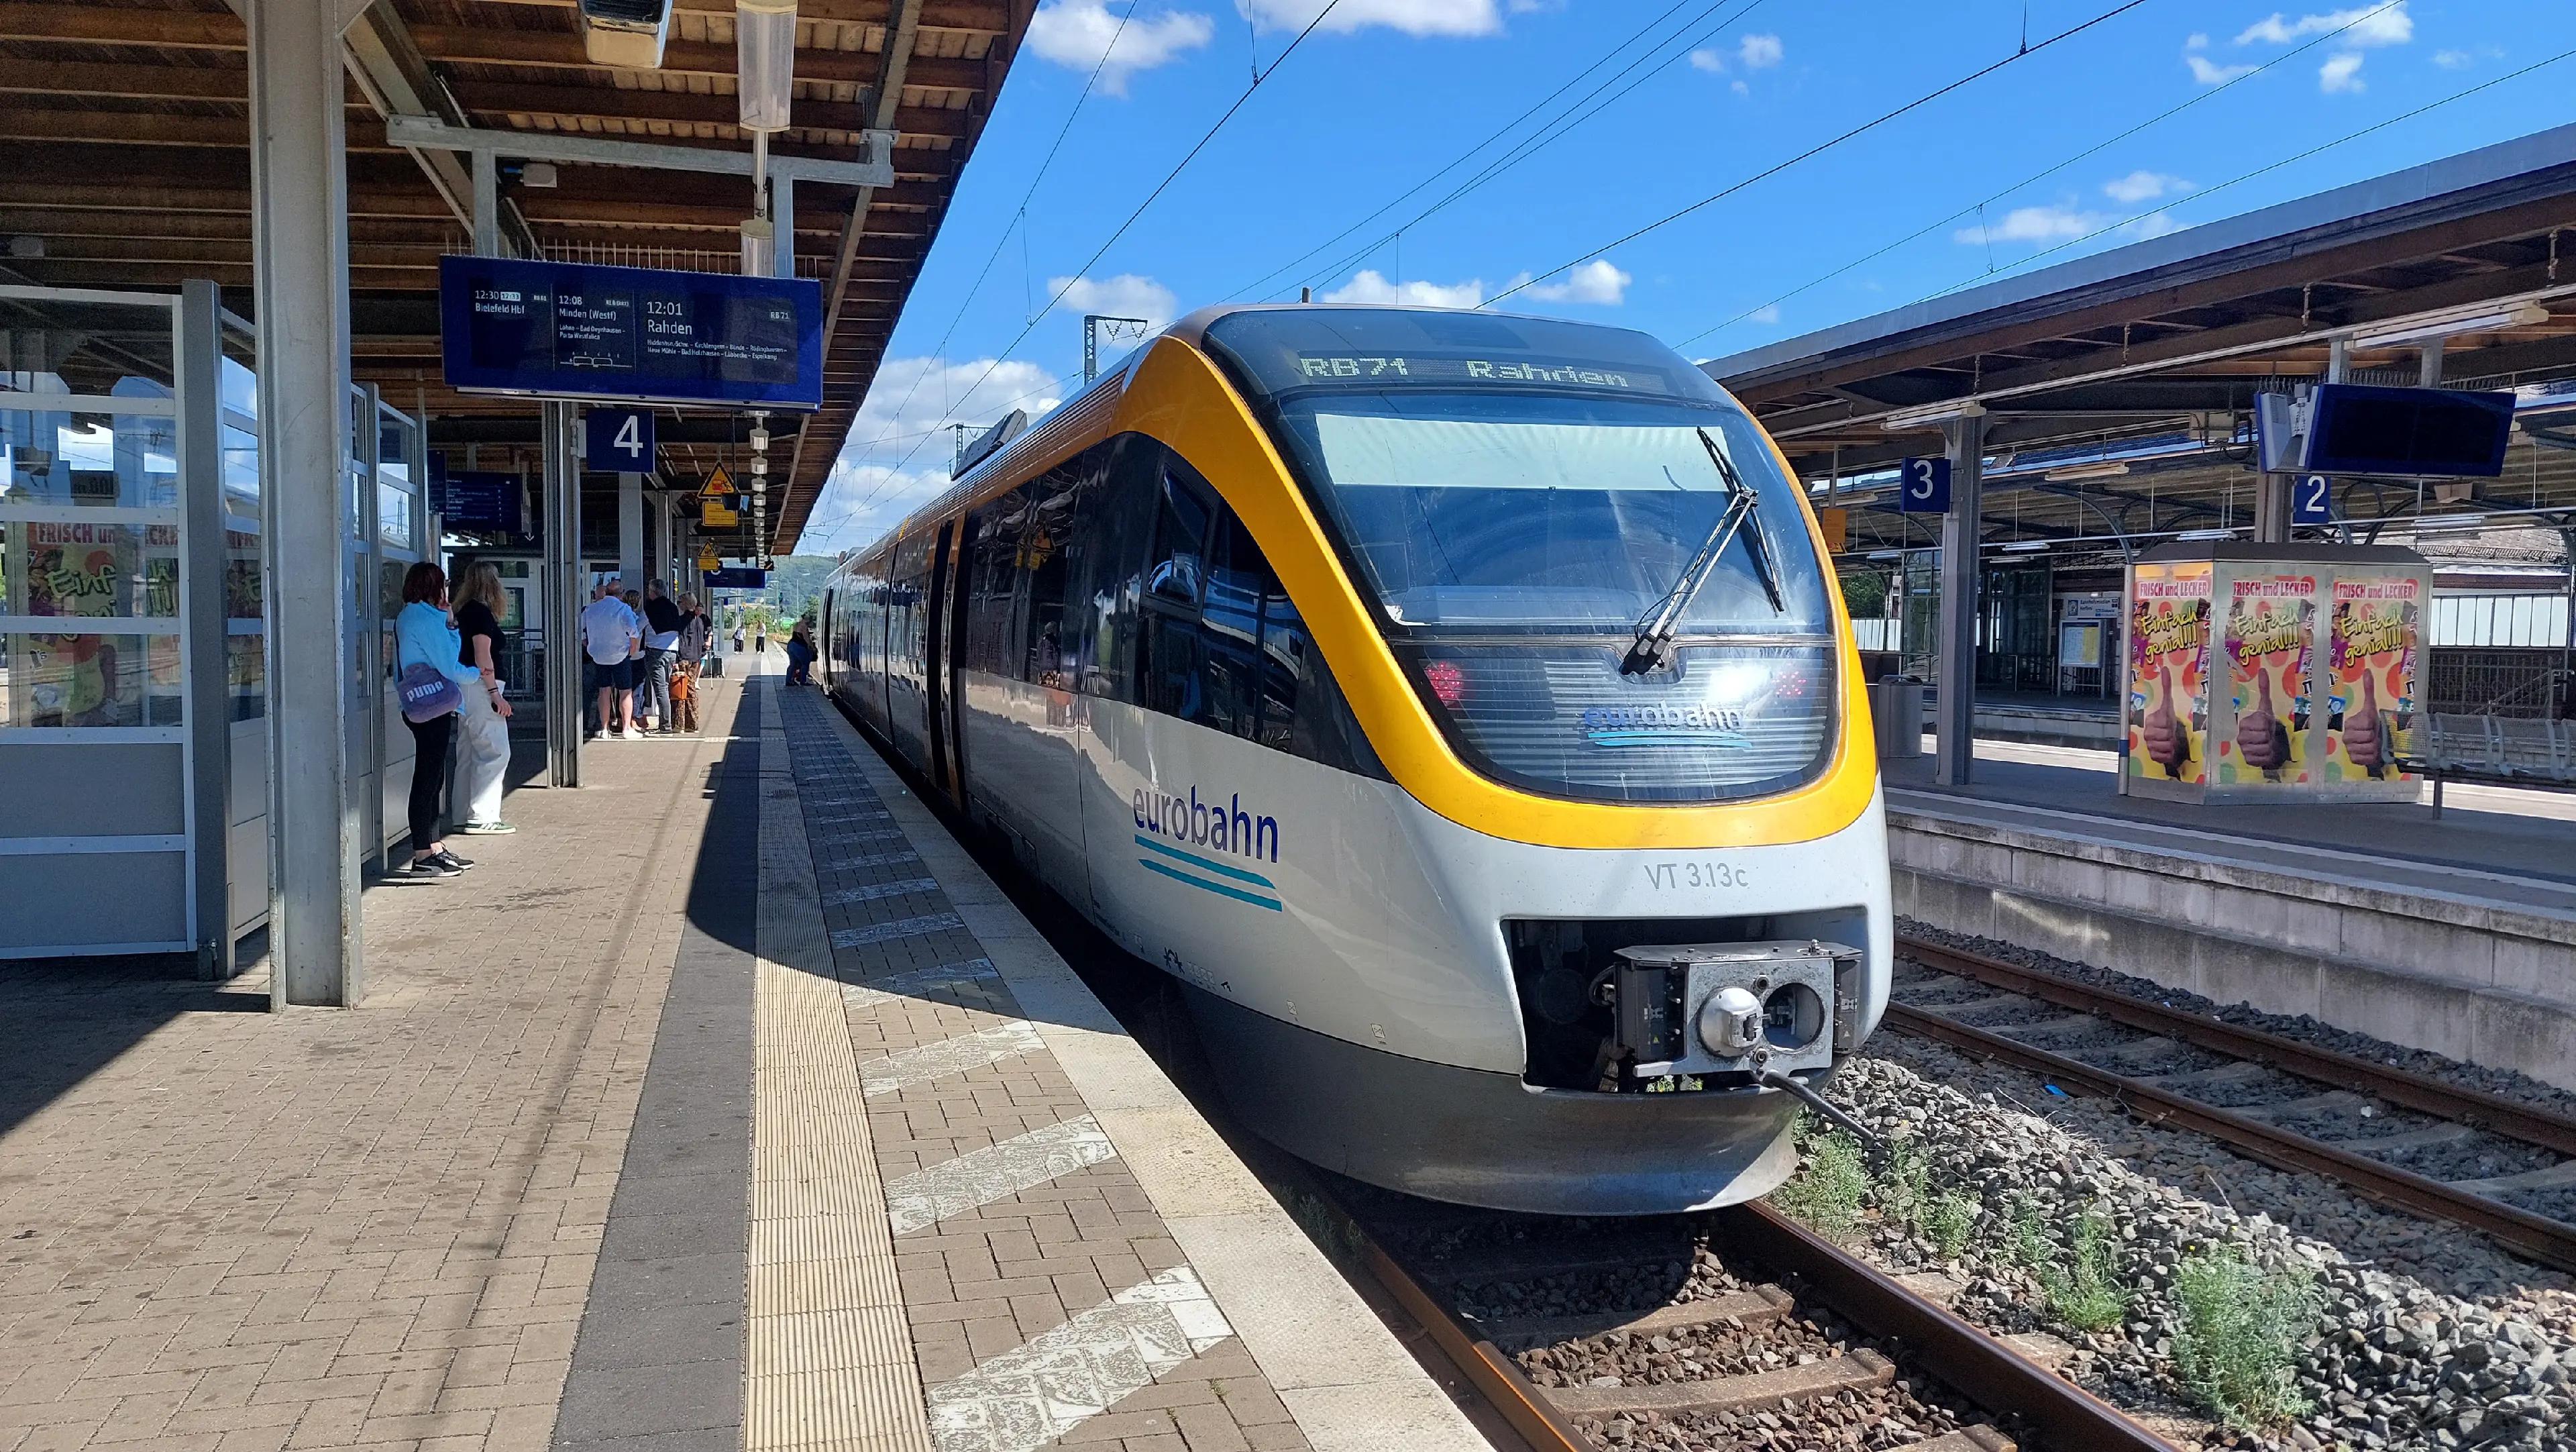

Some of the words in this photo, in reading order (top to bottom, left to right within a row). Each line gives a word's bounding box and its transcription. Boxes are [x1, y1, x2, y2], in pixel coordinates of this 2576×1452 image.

[475, 290, 499, 300] 12:30
[475, 302, 510, 313] Bielefeld
[511, 305, 525, 315] Hbf
[559, 295, 583, 305] 12:08
[647, 301, 683, 316] 12:01
[559, 308, 587, 319] Minden
[589, 309, 616, 321] (Westf)
[647, 319, 693, 335] Rahden
[1300, 358, 1408, 377] RB71
[1466, 360, 1628, 387] Rahden
[614, 415, 643, 458] 4
[1911, 460, 1933, 499] 3
[2305, 475, 2326, 512] 2
[2140, 582, 2163, 597] FRISCH
[2165, 582, 2178, 597] und
[2180, 582, 2207, 597] LECKER
[2263, 582, 2279, 597] und
[2281, 582, 2310, 597] LECKER
[2339, 584, 2366, 599] FRISCH
[2368, 584, 2383, 599] und
[2385, 584, 2414, 599] LECKER
[2141, 606, 2198, 635] Einfach
[2235, 607, 2300, 636] Einfach
[2341, 609, 2404, 637] Einfach
[2145, 624, 2198, 664] genial!!!
[2239, 625, 2300, 666] genial!!!
[2345, 627, 2403, 667] genial!!!
[1584, 699, 1744, 729] eurobahn
[1133, 784, 1278, 864] eurobahn
[1644, 863, 1677, 890] VT
[1686, 862, 1750, 888] 3.13c
